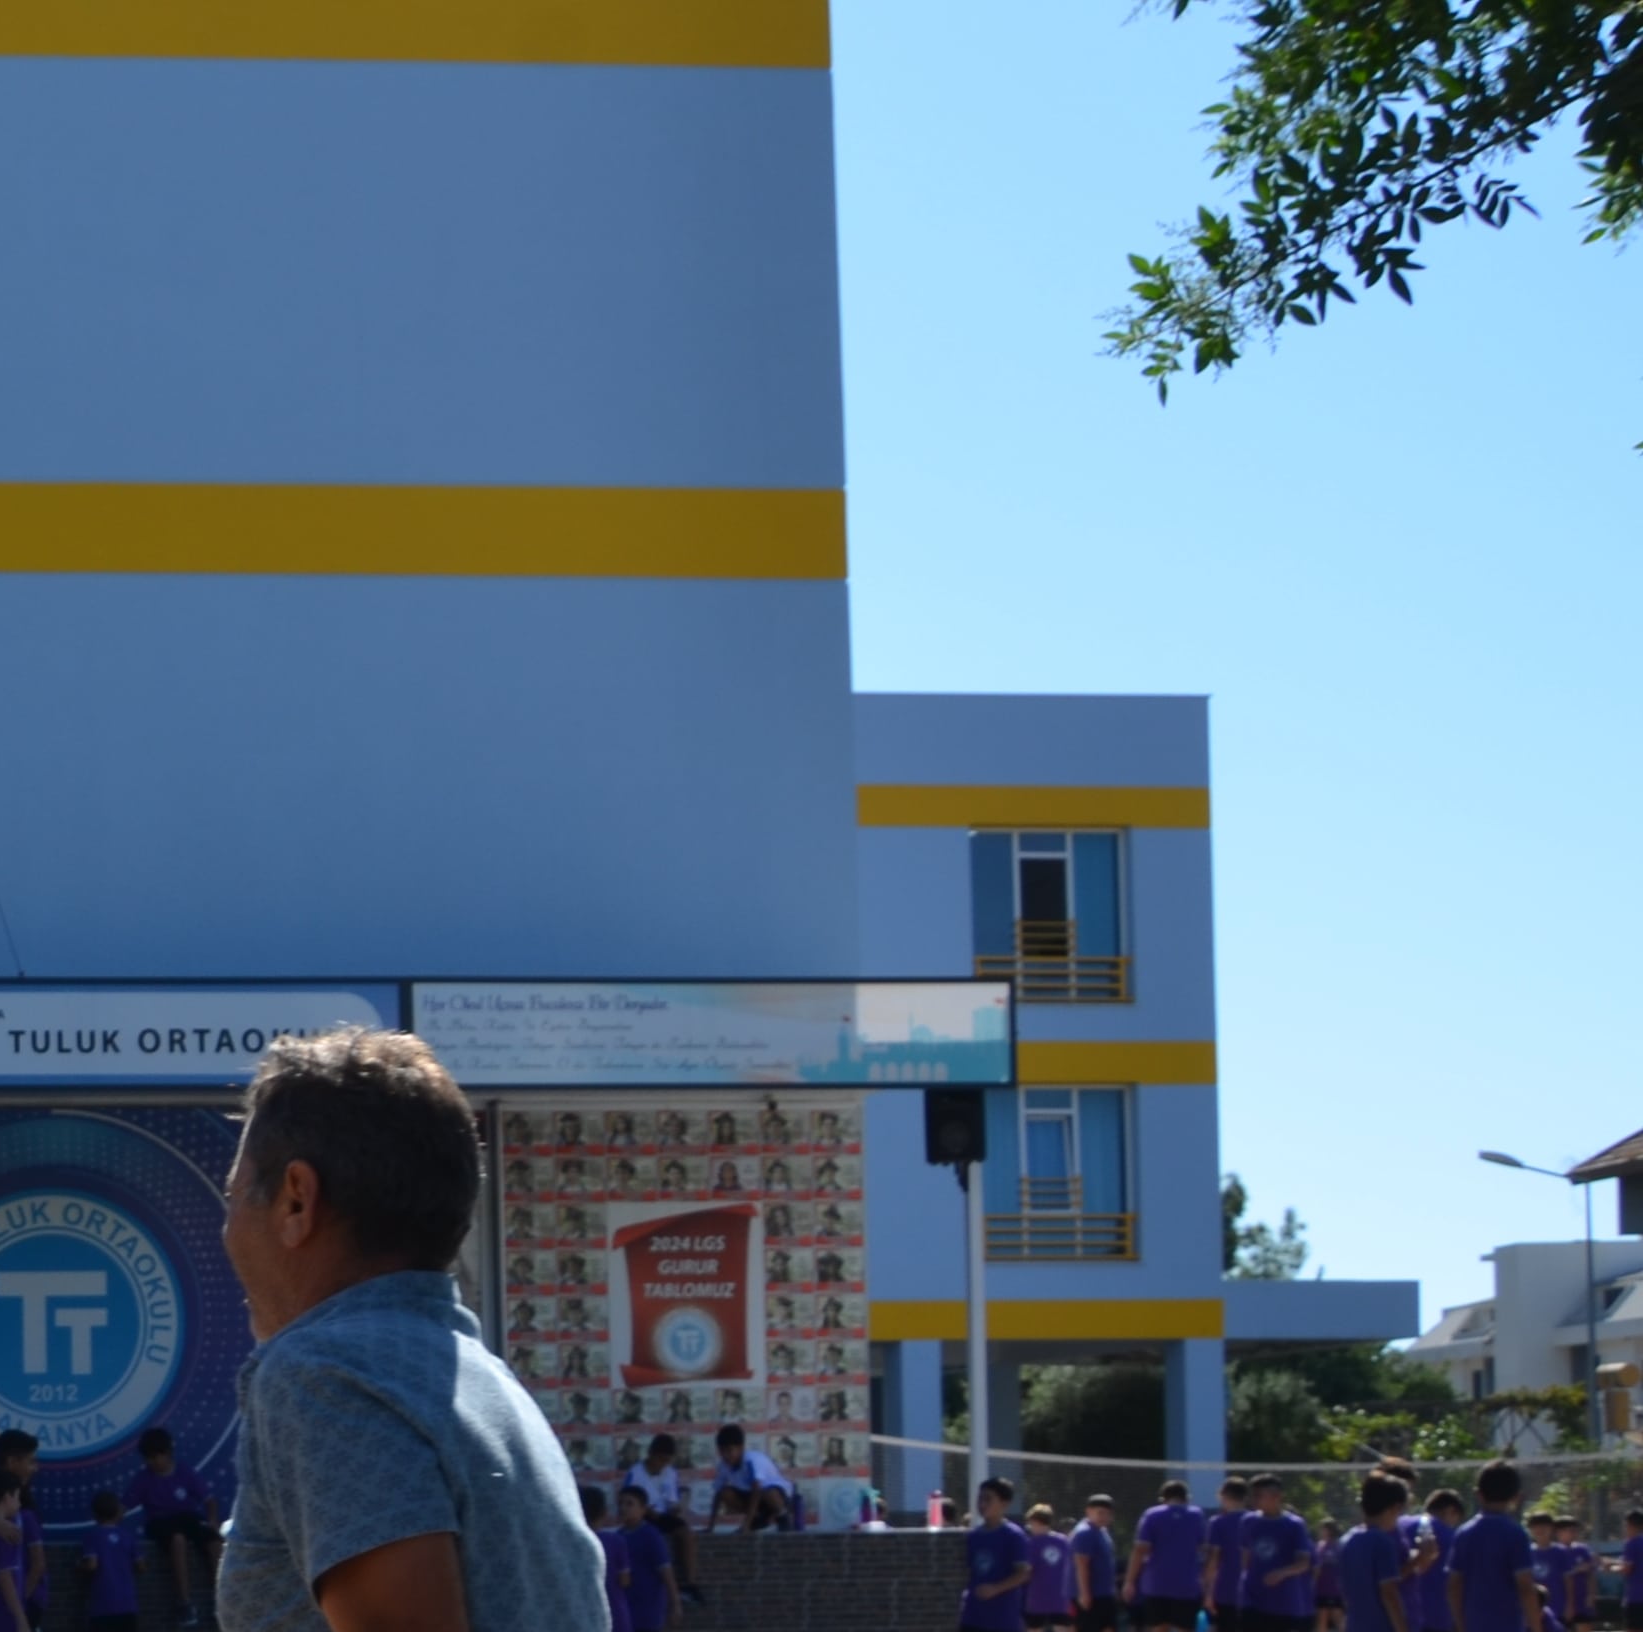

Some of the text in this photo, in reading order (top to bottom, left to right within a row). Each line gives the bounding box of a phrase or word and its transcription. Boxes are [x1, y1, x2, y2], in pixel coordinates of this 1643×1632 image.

[8, 1029, 120, 1053] TULUK
[649, 1235, 726, 1251] 2024 LGS
[657, 1259, 719, 1275] GURUR
[62, 1203, 172, 1364] ORTAOKULU
[643, 1282, 736, 1299] TABLOMUZ
[29, 1384, 77, 1402] 2012
